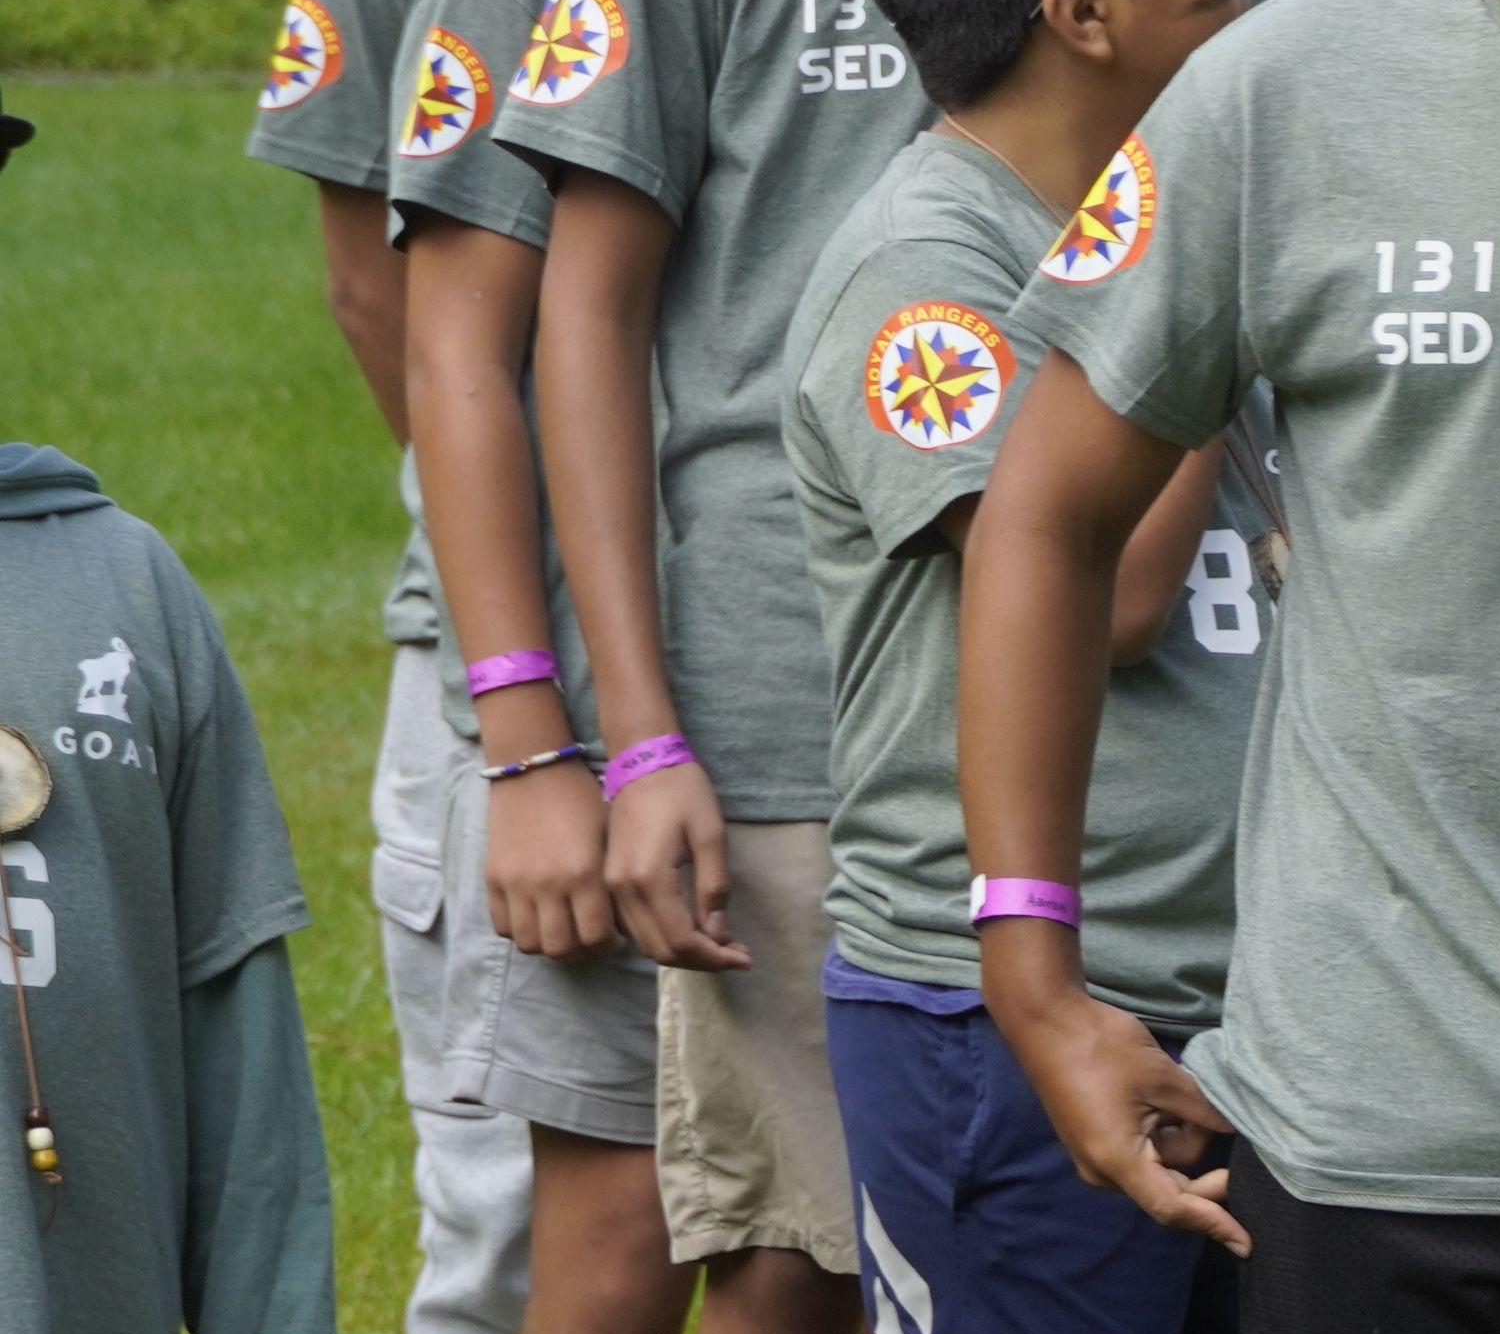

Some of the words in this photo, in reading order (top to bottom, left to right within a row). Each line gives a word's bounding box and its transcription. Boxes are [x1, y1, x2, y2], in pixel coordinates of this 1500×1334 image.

[799, 43, 907, 94] SED
[1375, 240, 1494, 293] 131
[898, 305, 1000, 348] RANGERS
[1372, 311, 1494, 366] SED
[1185, 528, 1263, 655] 8
